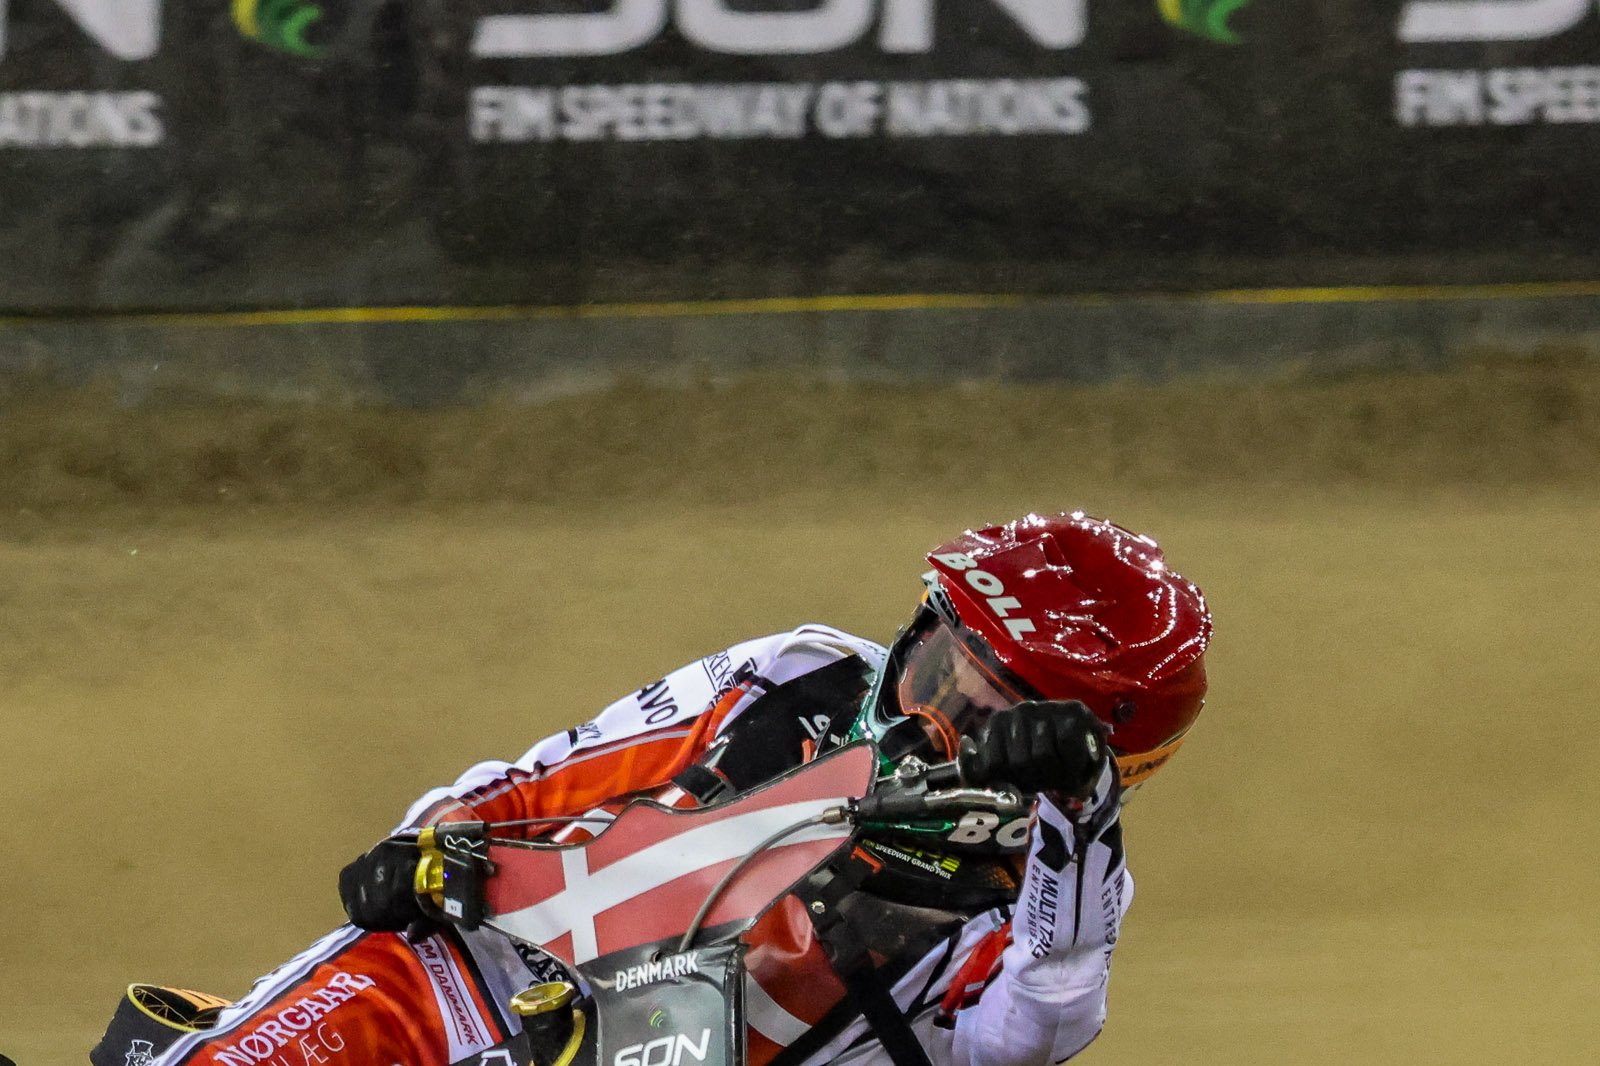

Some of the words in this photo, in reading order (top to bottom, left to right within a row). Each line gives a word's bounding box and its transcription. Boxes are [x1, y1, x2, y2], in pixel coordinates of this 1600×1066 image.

[469, 86, 558, 142] FIM
[560, 83, 811, 140] SPEEDWAY
[814, 81, 879, 138] OF
[886, 77, 1091, 136] NATIONS
[1394, 70, 1481, 125] FIM
[930, 551, 1037, 642] BOLL
[875, 844, 912, 863] SPEEDWAY
[911, 858, 936, 873] GRAND
[1040, 872, 1059, 929] MULTI
[615, 951, 700, 993] DENMARK
[431, 963, 480, 1046] DANMARK
